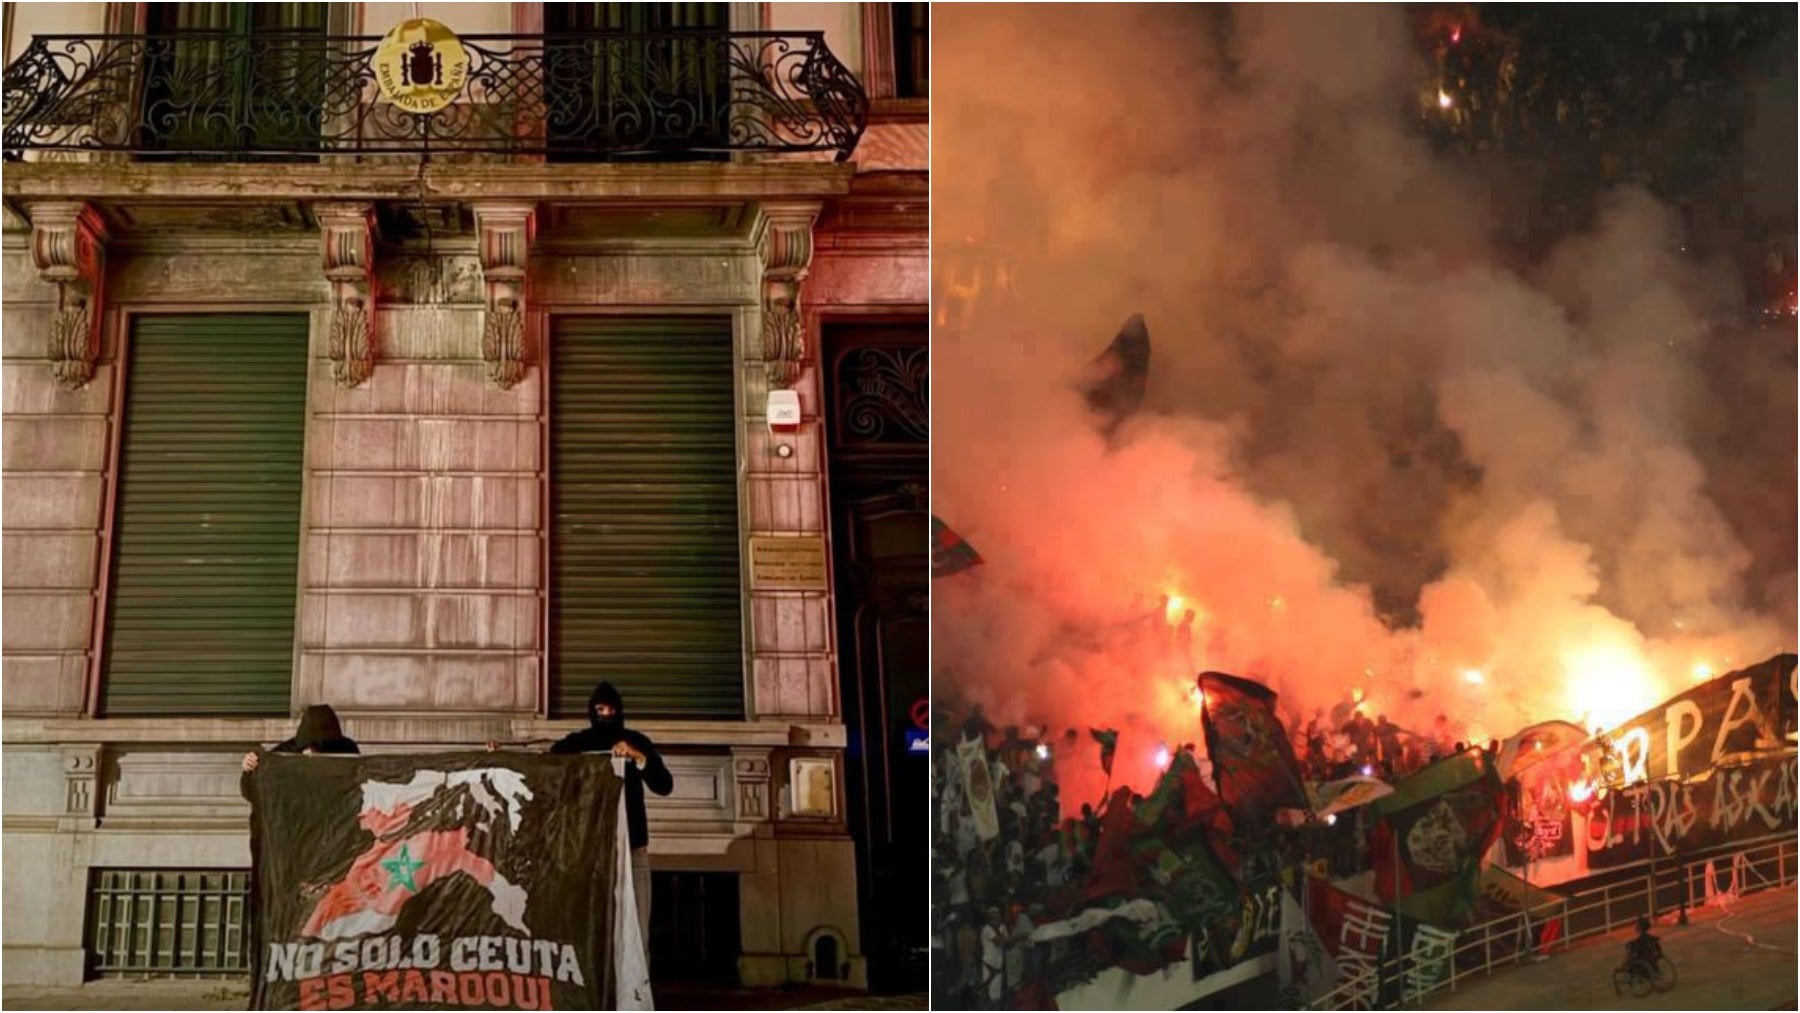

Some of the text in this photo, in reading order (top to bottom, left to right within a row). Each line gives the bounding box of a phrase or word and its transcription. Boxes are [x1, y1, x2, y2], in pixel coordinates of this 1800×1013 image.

[421, 98, 435, 108] DE
[266, 933, 585, 986] NO SOLO CEUTA
[300, 974, 354, 1010] ES
